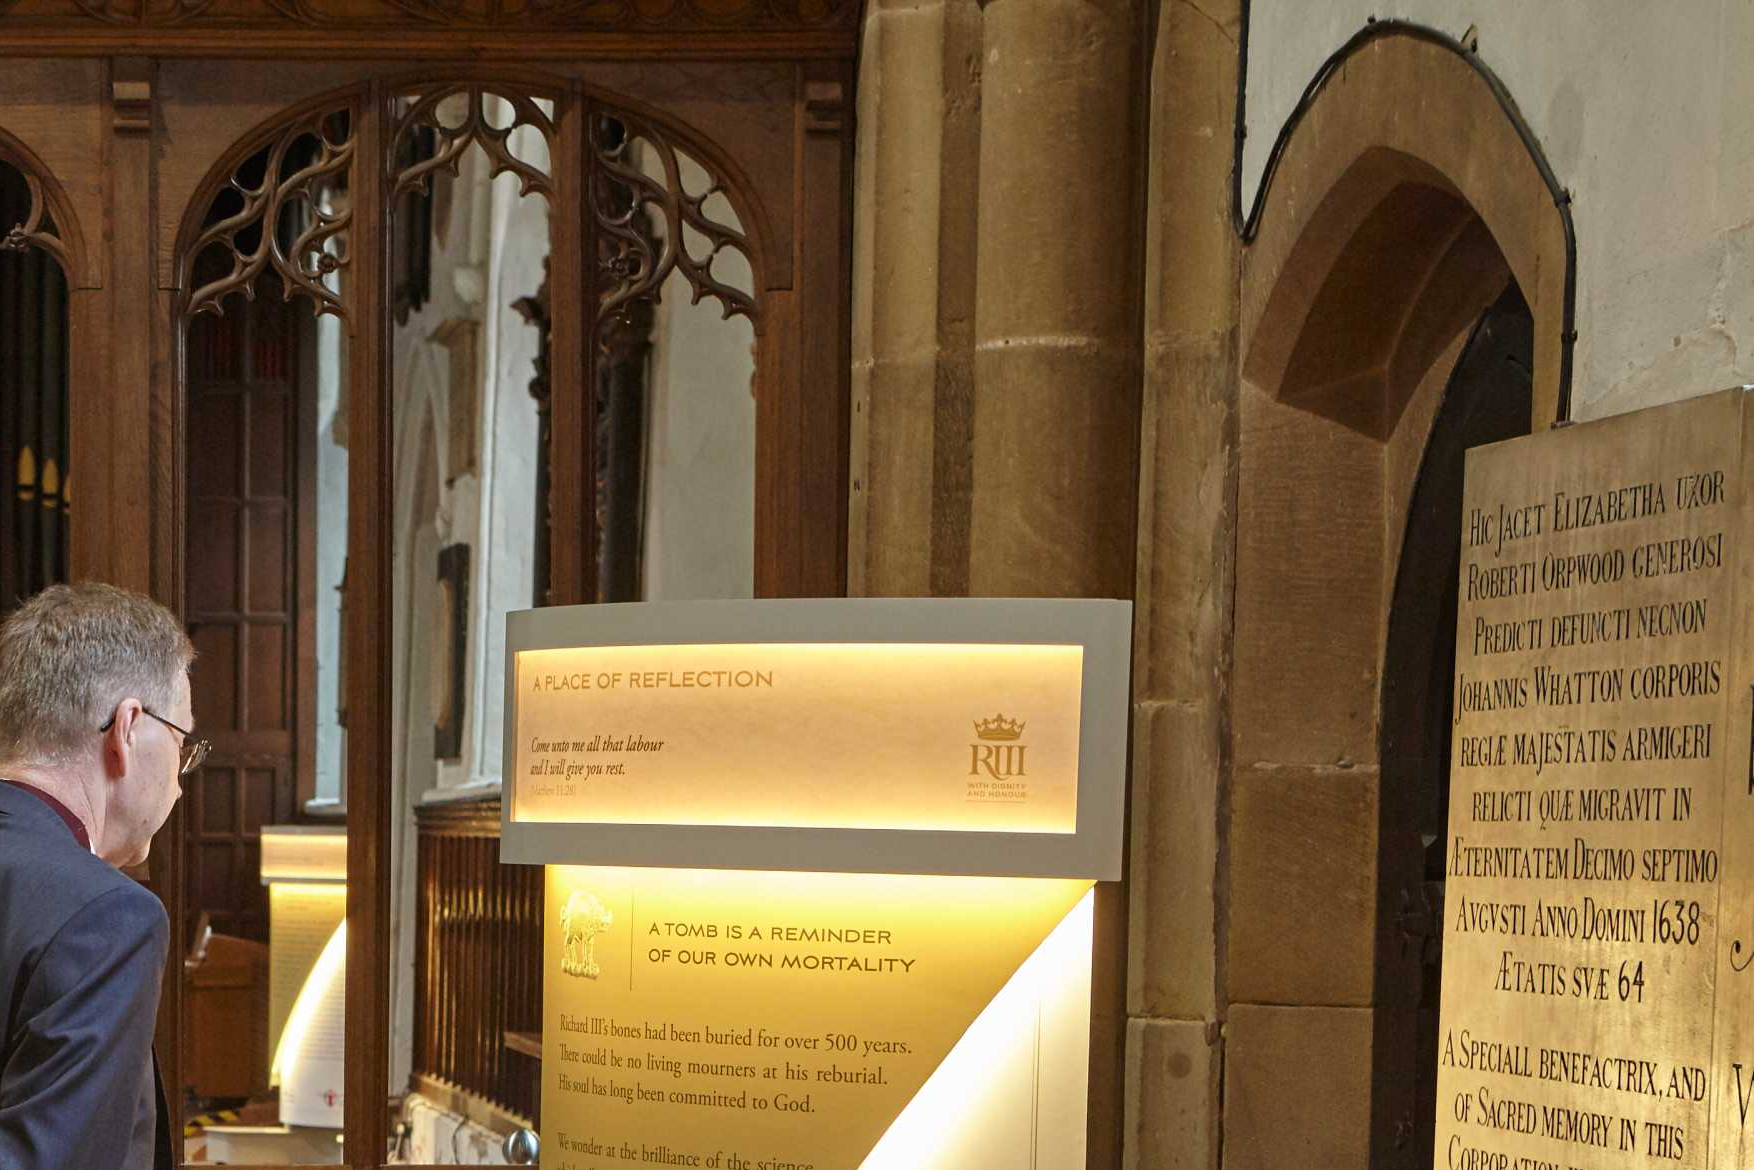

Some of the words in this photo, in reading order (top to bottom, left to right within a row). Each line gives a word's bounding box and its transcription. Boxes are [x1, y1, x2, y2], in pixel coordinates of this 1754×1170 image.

[533, 677, 541, 691] A
[545, 675, 591, 690] PLACE
[597, 673, 623, 689] OF
[629, 670, 774, 689] REFLECTION
[531, 736, 551, 753] Come
[551, 740, 570, 753] unto
[571, 741, 586, 752] me
[586, 735, 601, 752] all
[602, 736, 624, 752] that
[626, 734, 665, 753] labour
[530, 761, 543, 775] and
[549, 760, 565, 775] will
[565, 762, 584, 780] give
[585, 764, 603, 781] you
[605, 762, 626, 776] rest.
[649, 922, 660, 936] A
[664, 923, 718, 938] TOMB
[726, 925, 742, 939] IS
[748, 926, 762, 940] A
[771, 927, 891, 944] REMINDER
[1653, 899, 1700, 945] 1638
[649, 948, 672, 962] OF
[678, 950, 716, 965] OUR
[724, 952, 772, 968] OWN
[781, 955, 915, 973] MORTALITY
[1618, 960, 1645, 1003] 64
[560, 1014, 588, 1034] Richard
[591, 1018, 608, 1036] III's
[611, 1018, 641, 1038] bones
[645, 1022, 666, 1040] had
[671, 1024, 700, 1043] been
[706, 1025, 752, 1046] buried
[758, 1029, 780, 1047] for
[784, 1037, 820, 1049] over
[825, 1033, 857, 1051] 500
[863, 1041, 911, 1056] years.
[1442, 1029, 1455, 1067] A
[559, 1043, 579, 1062] There
[582, 1048, 606, 1066] could
[610, 1049, 623, 1067] be
[627, 1058, 642, 1069] no
[647, 1052, 682, 1077] living
[688, 1063, 755, 1077] mourners
[763, 1068, 777, 1079] at
[786, 1062, 808, 1080] his
[817, 1064, 887, 1085] reburial.
[558, 1073, 572, 1091] His
[572, 1077, 589, 1094] soul
[592, 1077, 607, 1096] has
[610, 1080, 634, 1102] long
[637, 1082, 664, 1102] been
[669, 1090, 746, 1109] committed
[753, 1098, 768, 1110] to
[774, 1093, 814, 1112] God.
